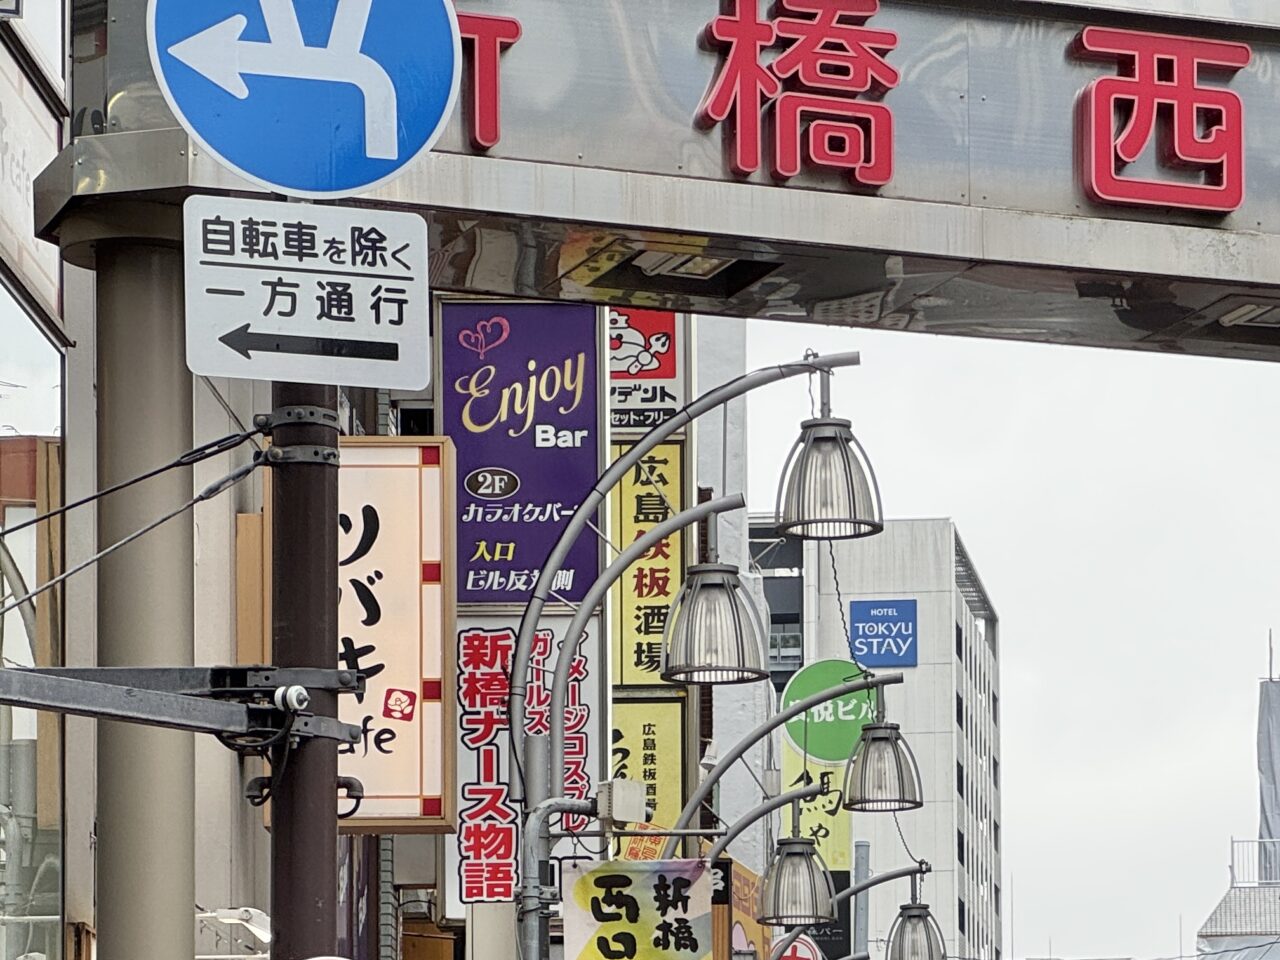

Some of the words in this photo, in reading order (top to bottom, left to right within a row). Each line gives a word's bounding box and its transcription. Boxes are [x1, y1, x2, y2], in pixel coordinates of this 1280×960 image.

[202, 216, 411, 271] 自転車を除く
[206, 276, 409, 326] 一方通行
[454, 352, 586, 437] Enjoy
[535, 424, 589, 448] Bar
[477, 473, 509, 494] 2F
[470, 541, 516, 562] 入口
[870, 608, 898, 617] HOTEL
[854, 622, 913, 637] TOKYU
[854, 637, 913, 657] STAY
[461, 631, 517, 903] 新橋ナース物語
[653, 874, 698, 953] 新橋
